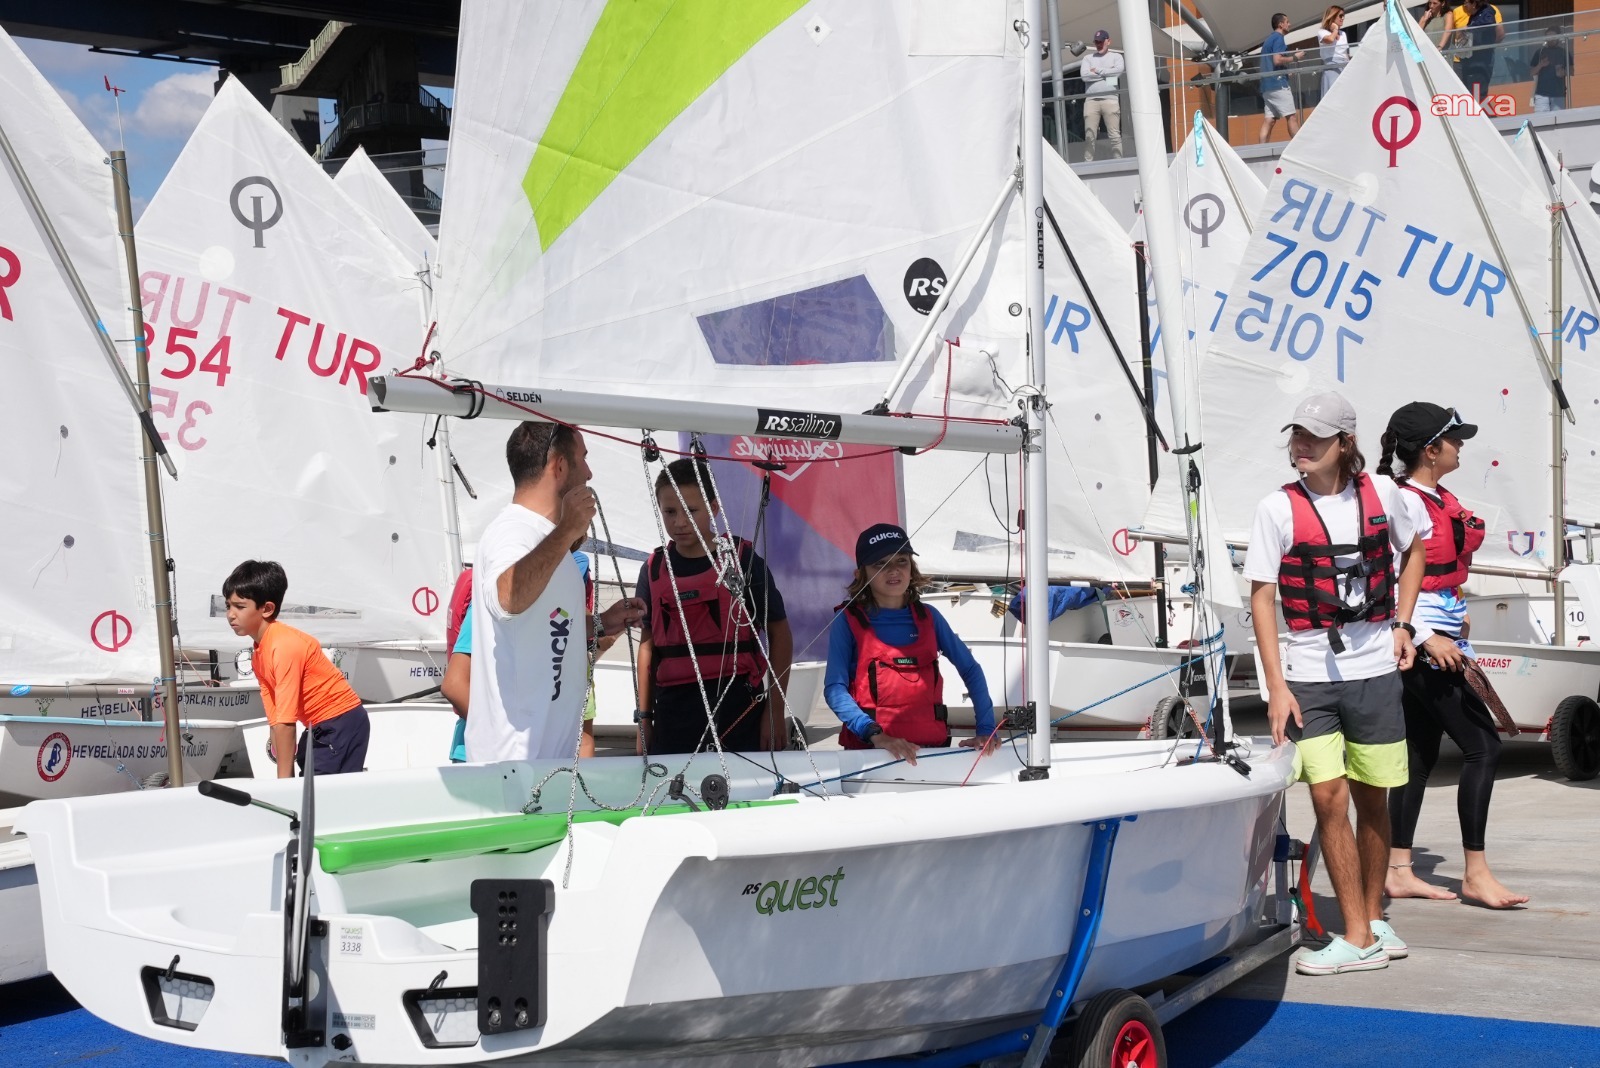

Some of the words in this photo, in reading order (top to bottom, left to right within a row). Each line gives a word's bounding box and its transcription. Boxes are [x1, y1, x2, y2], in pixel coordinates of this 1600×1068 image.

[1251, 232, 1382, 322] 7015
[1397, 225, 1506, 318] TUR
[909, 277, 944, 297] RS
[275, 307, 381, 396] TUR
[506, 391, 542, 404] SELDÉN
[868, 531, 901, 545] QUICK
[1568, 611, 1585, 622] 10
[1476, 657, 1512, 669] FAREAST
[177, 694, 216, 707] PORLARI
[136, 745, 149, 759] SU
[340, 941, 362, 953] 3338
